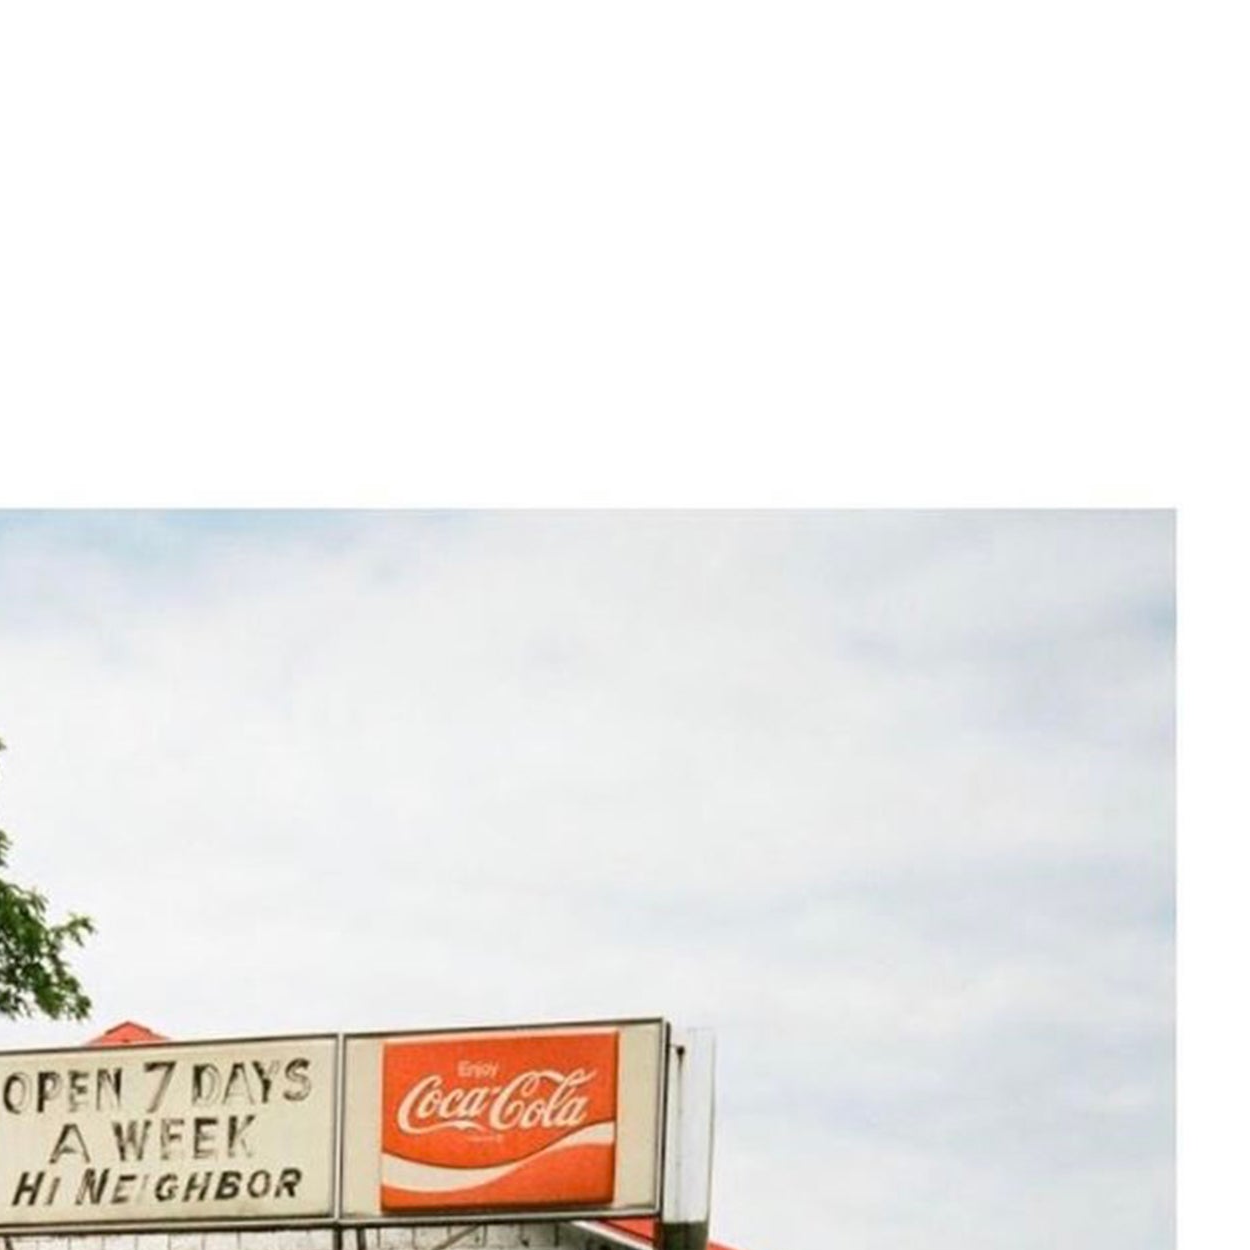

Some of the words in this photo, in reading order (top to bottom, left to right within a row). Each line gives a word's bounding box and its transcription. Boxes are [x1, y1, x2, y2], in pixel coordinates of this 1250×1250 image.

[3, 1067, 123, 1115] OPEN
[143, 1060, 177, 1114] 7
[191, 1057, 313, 1106] DAYS
[457, 1060, 500, 1079] Enjoy
[397, 1068, 598, 1133] Coca-Cola
[48, 1123, 91, 1165] A
[112, 1114, 257, 1162] WEEK
[75, 1167, 304, 1206] NEIGHBOR
